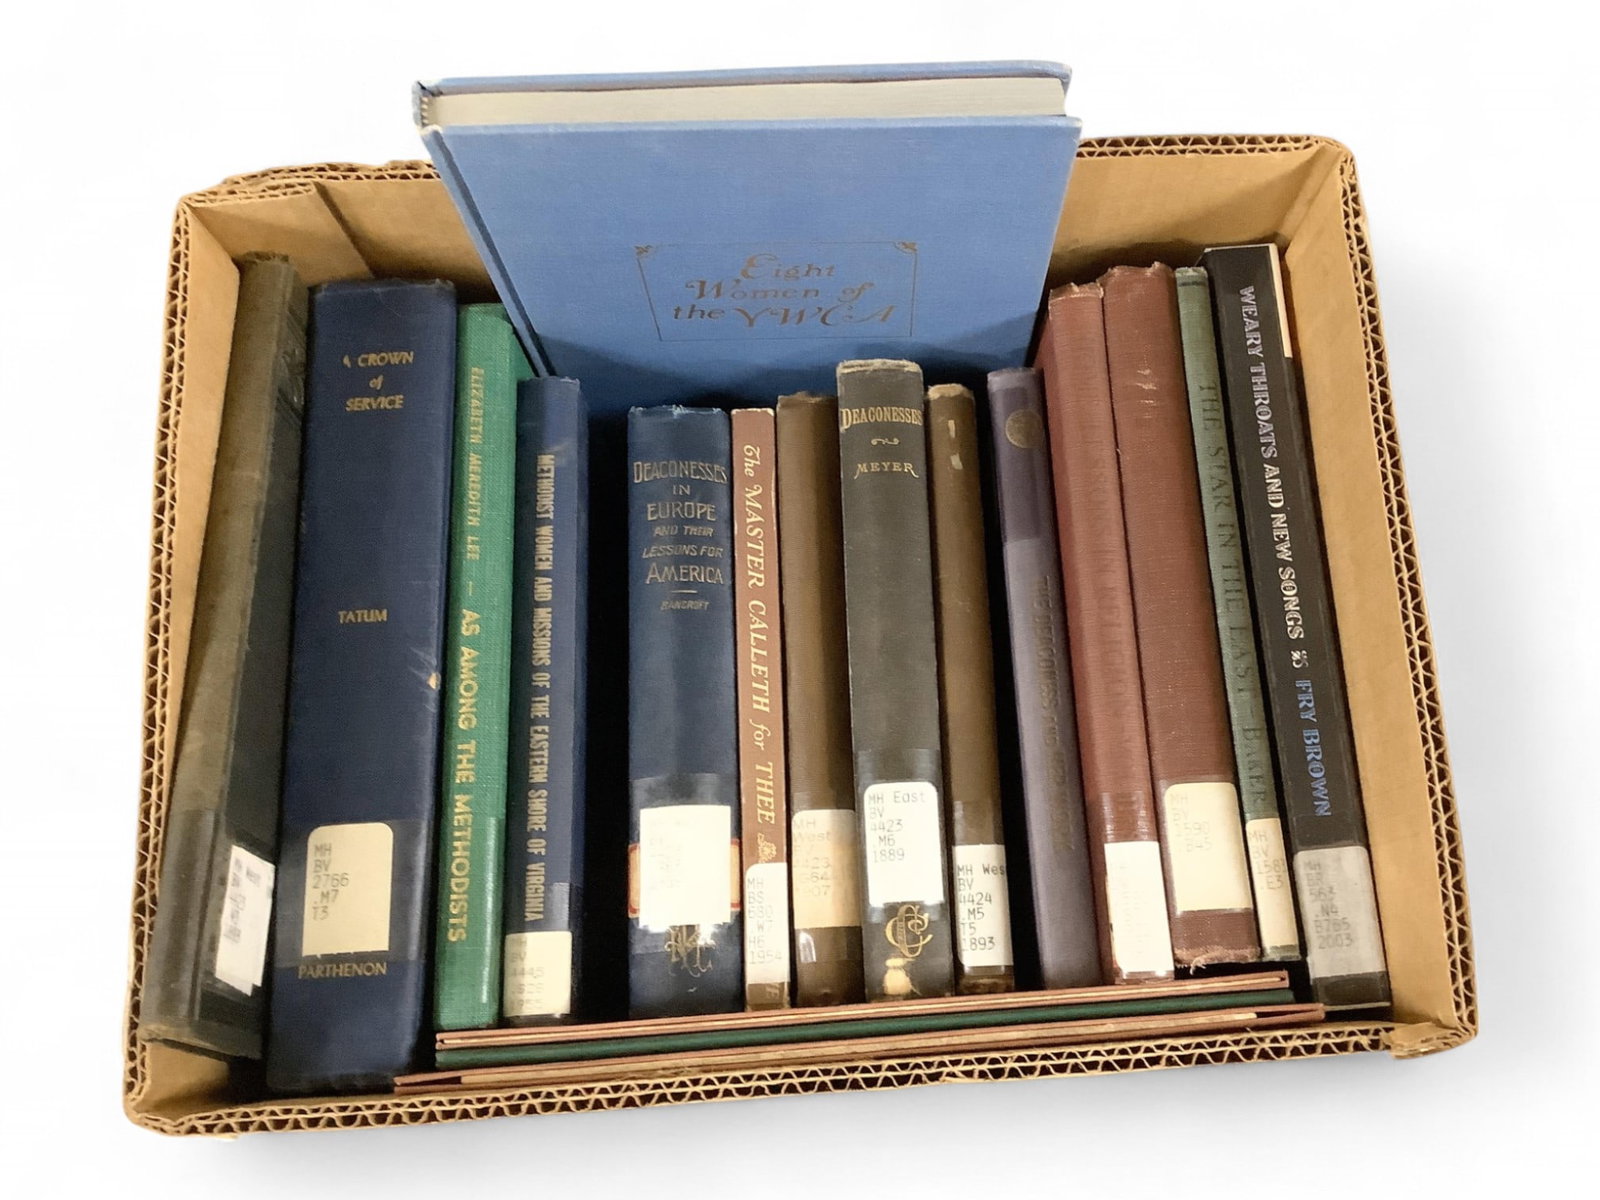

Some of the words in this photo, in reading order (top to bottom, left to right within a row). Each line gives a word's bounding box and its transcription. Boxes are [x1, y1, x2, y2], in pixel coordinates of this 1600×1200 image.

[739, 253, 836, 281] Eight
[685, 278, 820, 300] Women
[836, 281, 874, 303] of
[673, 304, 725, 320] the
[735, 304, 896, 328] YWCA
[1239, 286, 1264, 358] WEARY
[358, 351, 414, 367] CROWN
[369, 374, 384, 390] of
[345, 394, 404, 412] SERVICE
[469, 367, 484, 444] ELIZABETH
[1199, 382, 1222, 431] THE
[1250, 362, 1278, 459] THROATS
[839, 406, 923, 433] DEACONESSES
[633, 460, 728, 484] DEACONESSES
[743, 444, 761, 477] The
[854, 462, 920, 480] MEYER
[468, 452, 482, 527] MEREDITH
[536, 454, 556, 520] METHODIST
[672, 484, 691, 496] IN
[1207, 445, 1233, 512] STAR
[1263, 463, 1283, 508] AND
[646, 501, 717, 522] EUROPE
[653, 525, 679, 537] AND
[682, 525, 714, 538] THEIR
[745, 484, 765, 589] MASTER
[1218, 521, 1235, 550] IN
[1271, 512, 1293, 562] NEW
[466, 536, 481, 561] LEE
[534, 525, 555, 570] WOMEN
[642, 544, 698, 559] LESSONS
[699, 545, 724, 559] FOR
[645, 562, 724, 585] AMERICA
[533, 576, 553, 602] AND
[1222, 563, 1245, 614] THE
[338, 608, 388, 624] TATUM
[659, 599, 710, 611] BANCROFT
[1278, 566, 1304, 640] SONGS
[460, 609, 480, 637] AS
[532, 607, 552, 667] MISSIONS
[749, 599, 771, 713] CALLETH
[457, 646, 480, 731] AMONG
[531, 672, 550, 689] OF
[530, 694, 550, 719] THE
[1295, 680, 1317, 723] FRY
[749, 718, 771, 750] for
[455, 740, 476, 784] THE
[528, 725, 549, 784] EASTERN
[1303, 729, 1332, 817] BROWN
[755, 761, 775, 825] THEE
[868, 792, 884, 806] MH
[893, 791, 926, 804] East
[526, 788, 548, 832] SHORE
[313, 843, 332, 857] MH
[526, 840, 547, 856] OF
[873, 848, 905, 864] 1889
[313, 859, 331, 873] BV
[447, 794, 473, 943] METHODISTS
[957, 864, 974, 877] MH
[312, 873, 350, 889] 2766
[524, 861, 545, 922] VIRGINIA
[959, 892, 993, 906] 4424
[960, 936, 996, 952] 1893
[298, 961, 387, 980] PARTHENON
